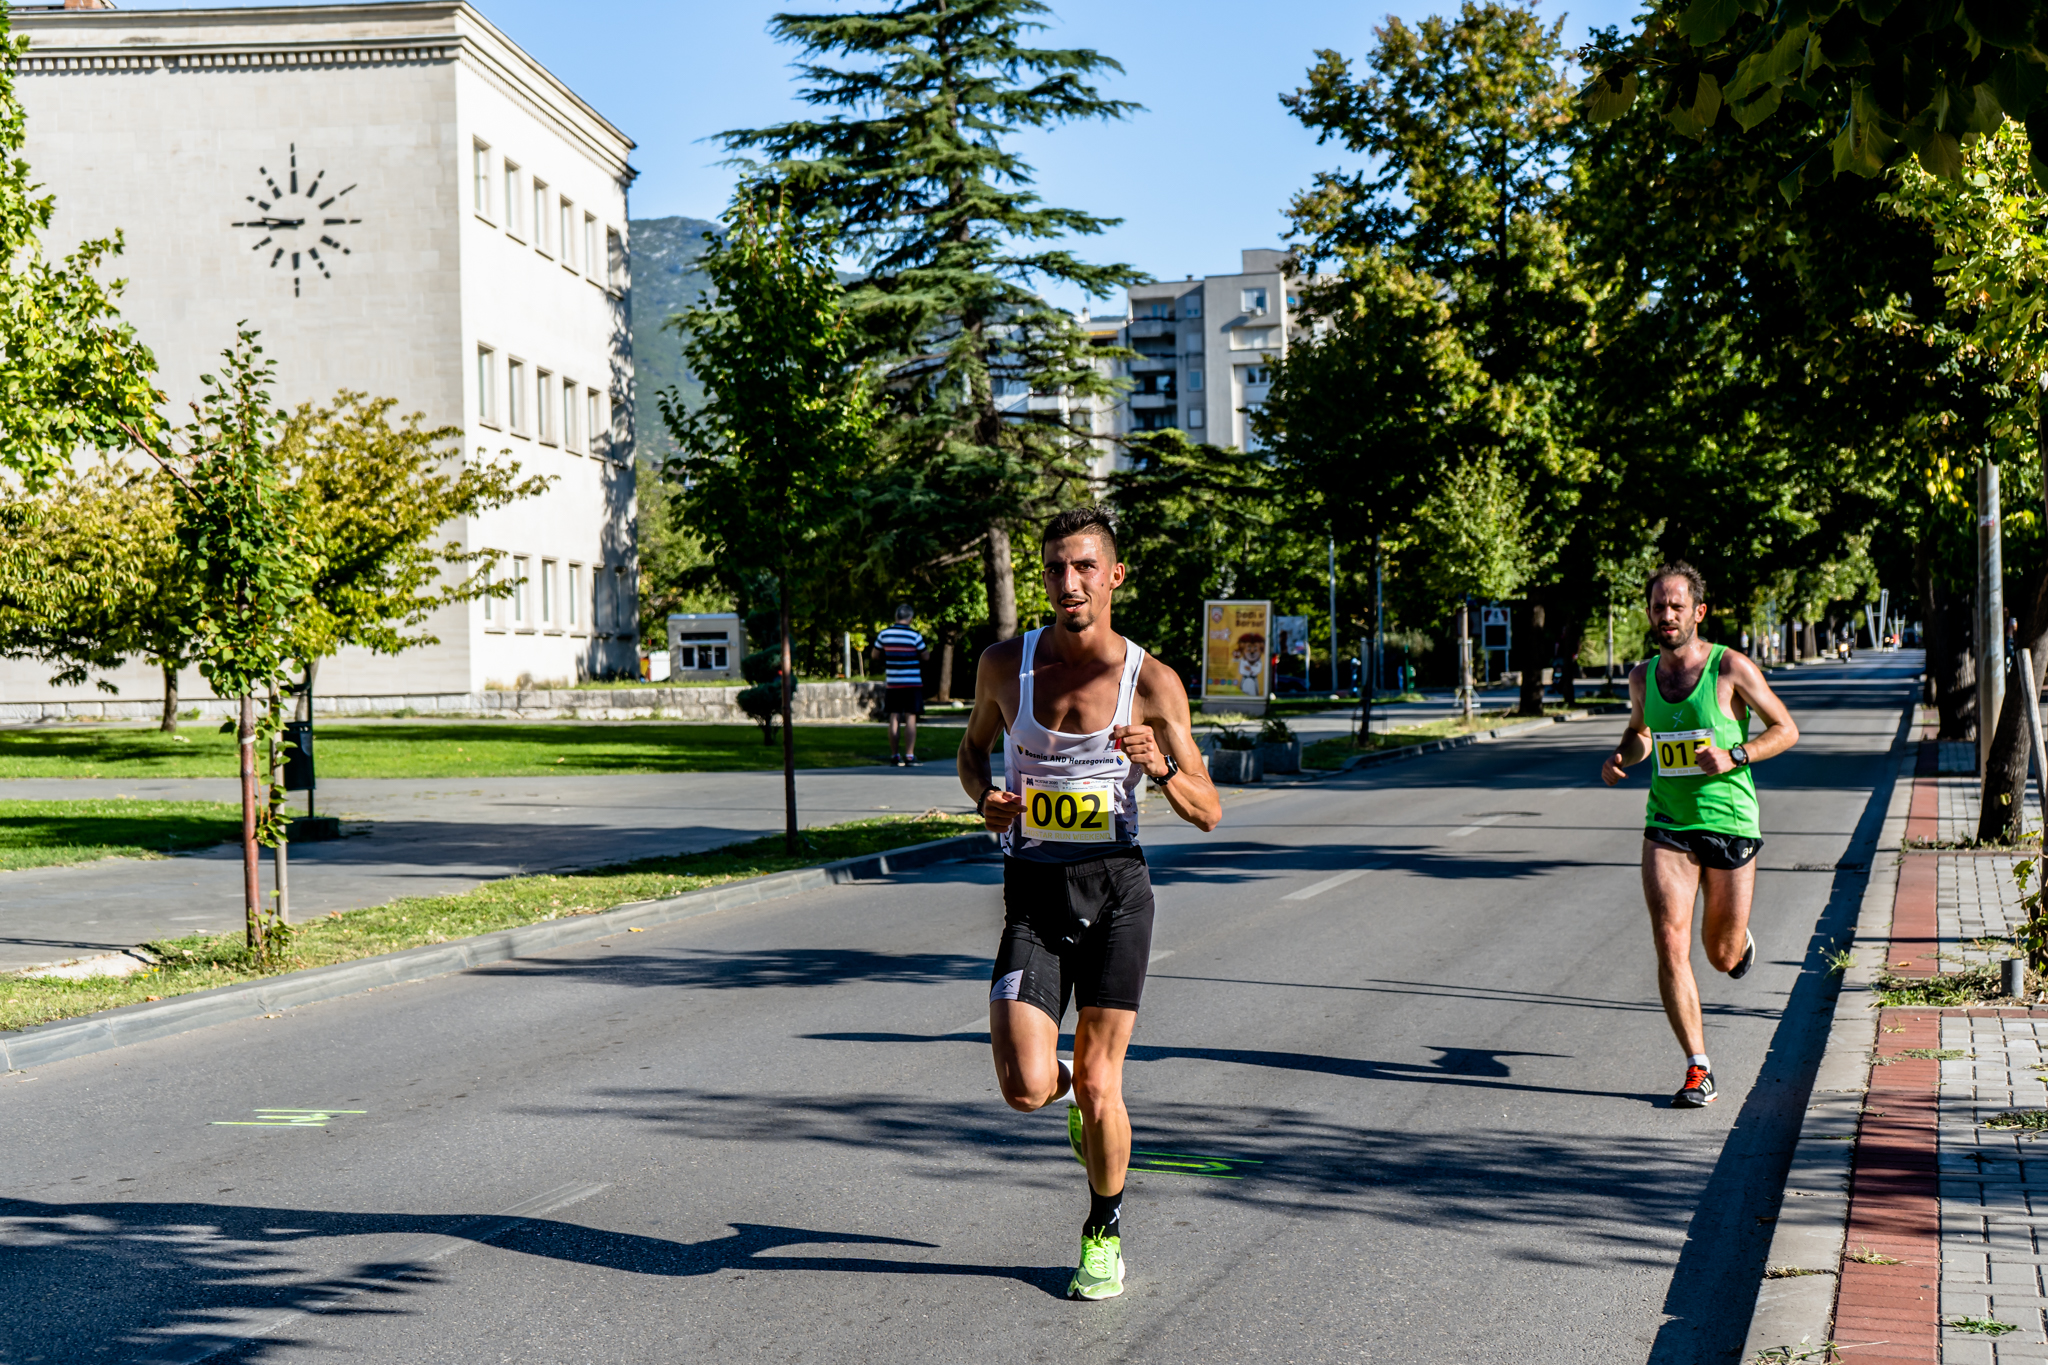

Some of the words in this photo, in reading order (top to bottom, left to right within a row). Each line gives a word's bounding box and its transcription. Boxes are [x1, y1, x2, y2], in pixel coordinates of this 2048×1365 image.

[1025, 749, 1047, 760] Bosnia
[1050, 755, 1067, 763] AND
[1069, 757, 1114, 766] Herzegovina
[1032, 792, 1102, 829] 002
[1025, 829, 1052, 839] MOSTAR
[1054, 832, 1071, 840] RUN
[1073, 832, 1111, 841] WEEKEND
